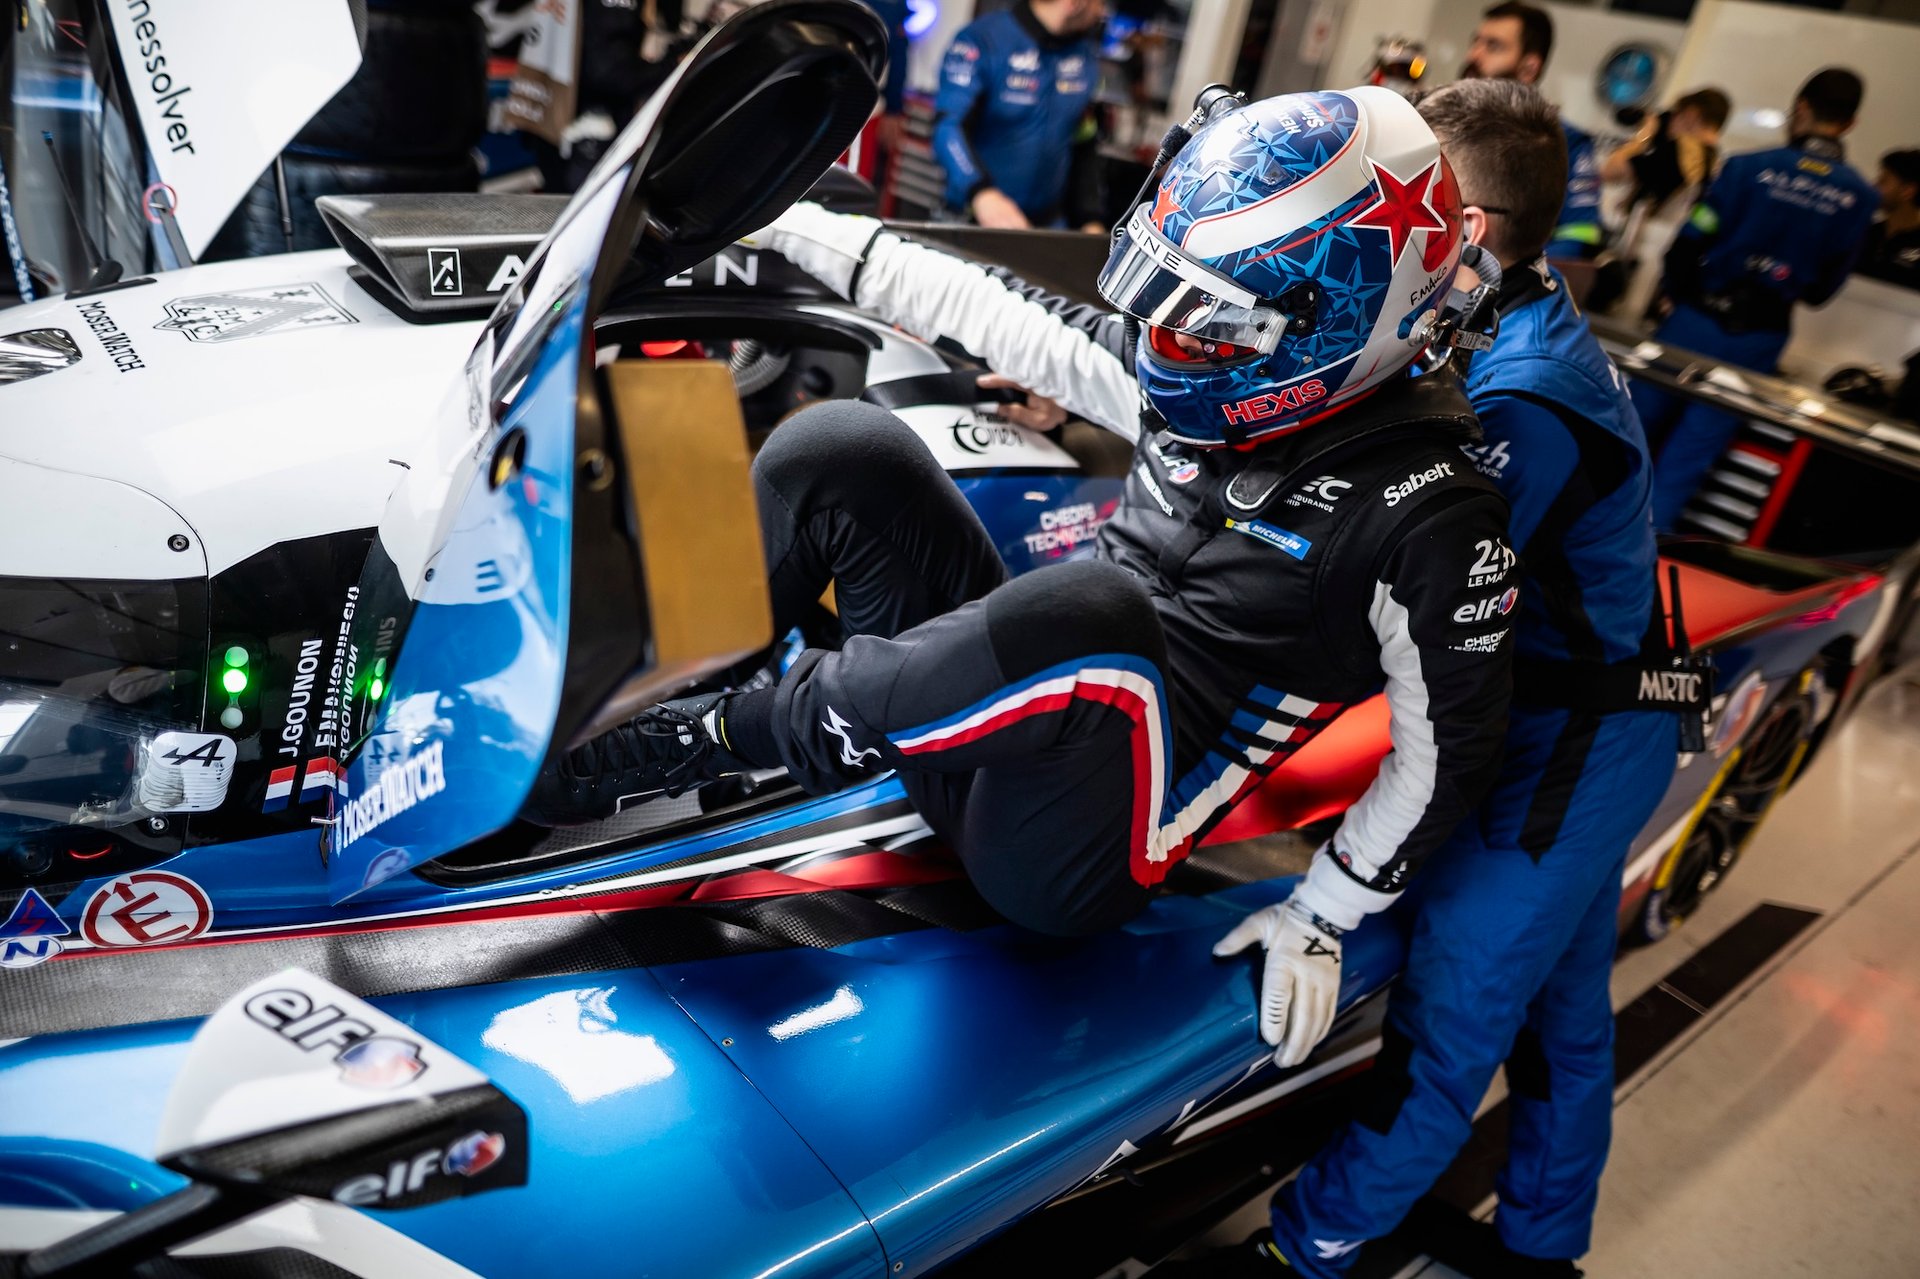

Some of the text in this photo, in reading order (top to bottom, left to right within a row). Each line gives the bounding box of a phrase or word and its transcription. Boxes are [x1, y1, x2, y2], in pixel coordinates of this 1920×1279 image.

[126, 0, 196, 154] nessolver
[1131, 218, 1182, 271] PINE
[76, 300, 146, 373] MOSER.WATCH
[1221, 379, 1327, 425] HEXIS
[1383, 462, 1455, 508] Sabelt
[1475, 464, 1501, 478] ANS
[1291, 493, 1335, 514] NDURANCE
[1252, 523, 1302, 551] MICHELIN
[1467, 569, 1508, 588] LE MA
[1453, 595, 1501, 624] elf
[1464, 628, 1509, 648] CHEOP
[279, 638, 323, 758] J.GOUNON
[1638, 670, 1703, 703] MRTC
[3, 940, 49, 961] N
[244, 988, 377, 1053] elf
[332, 1149, 445, 1206] elf
